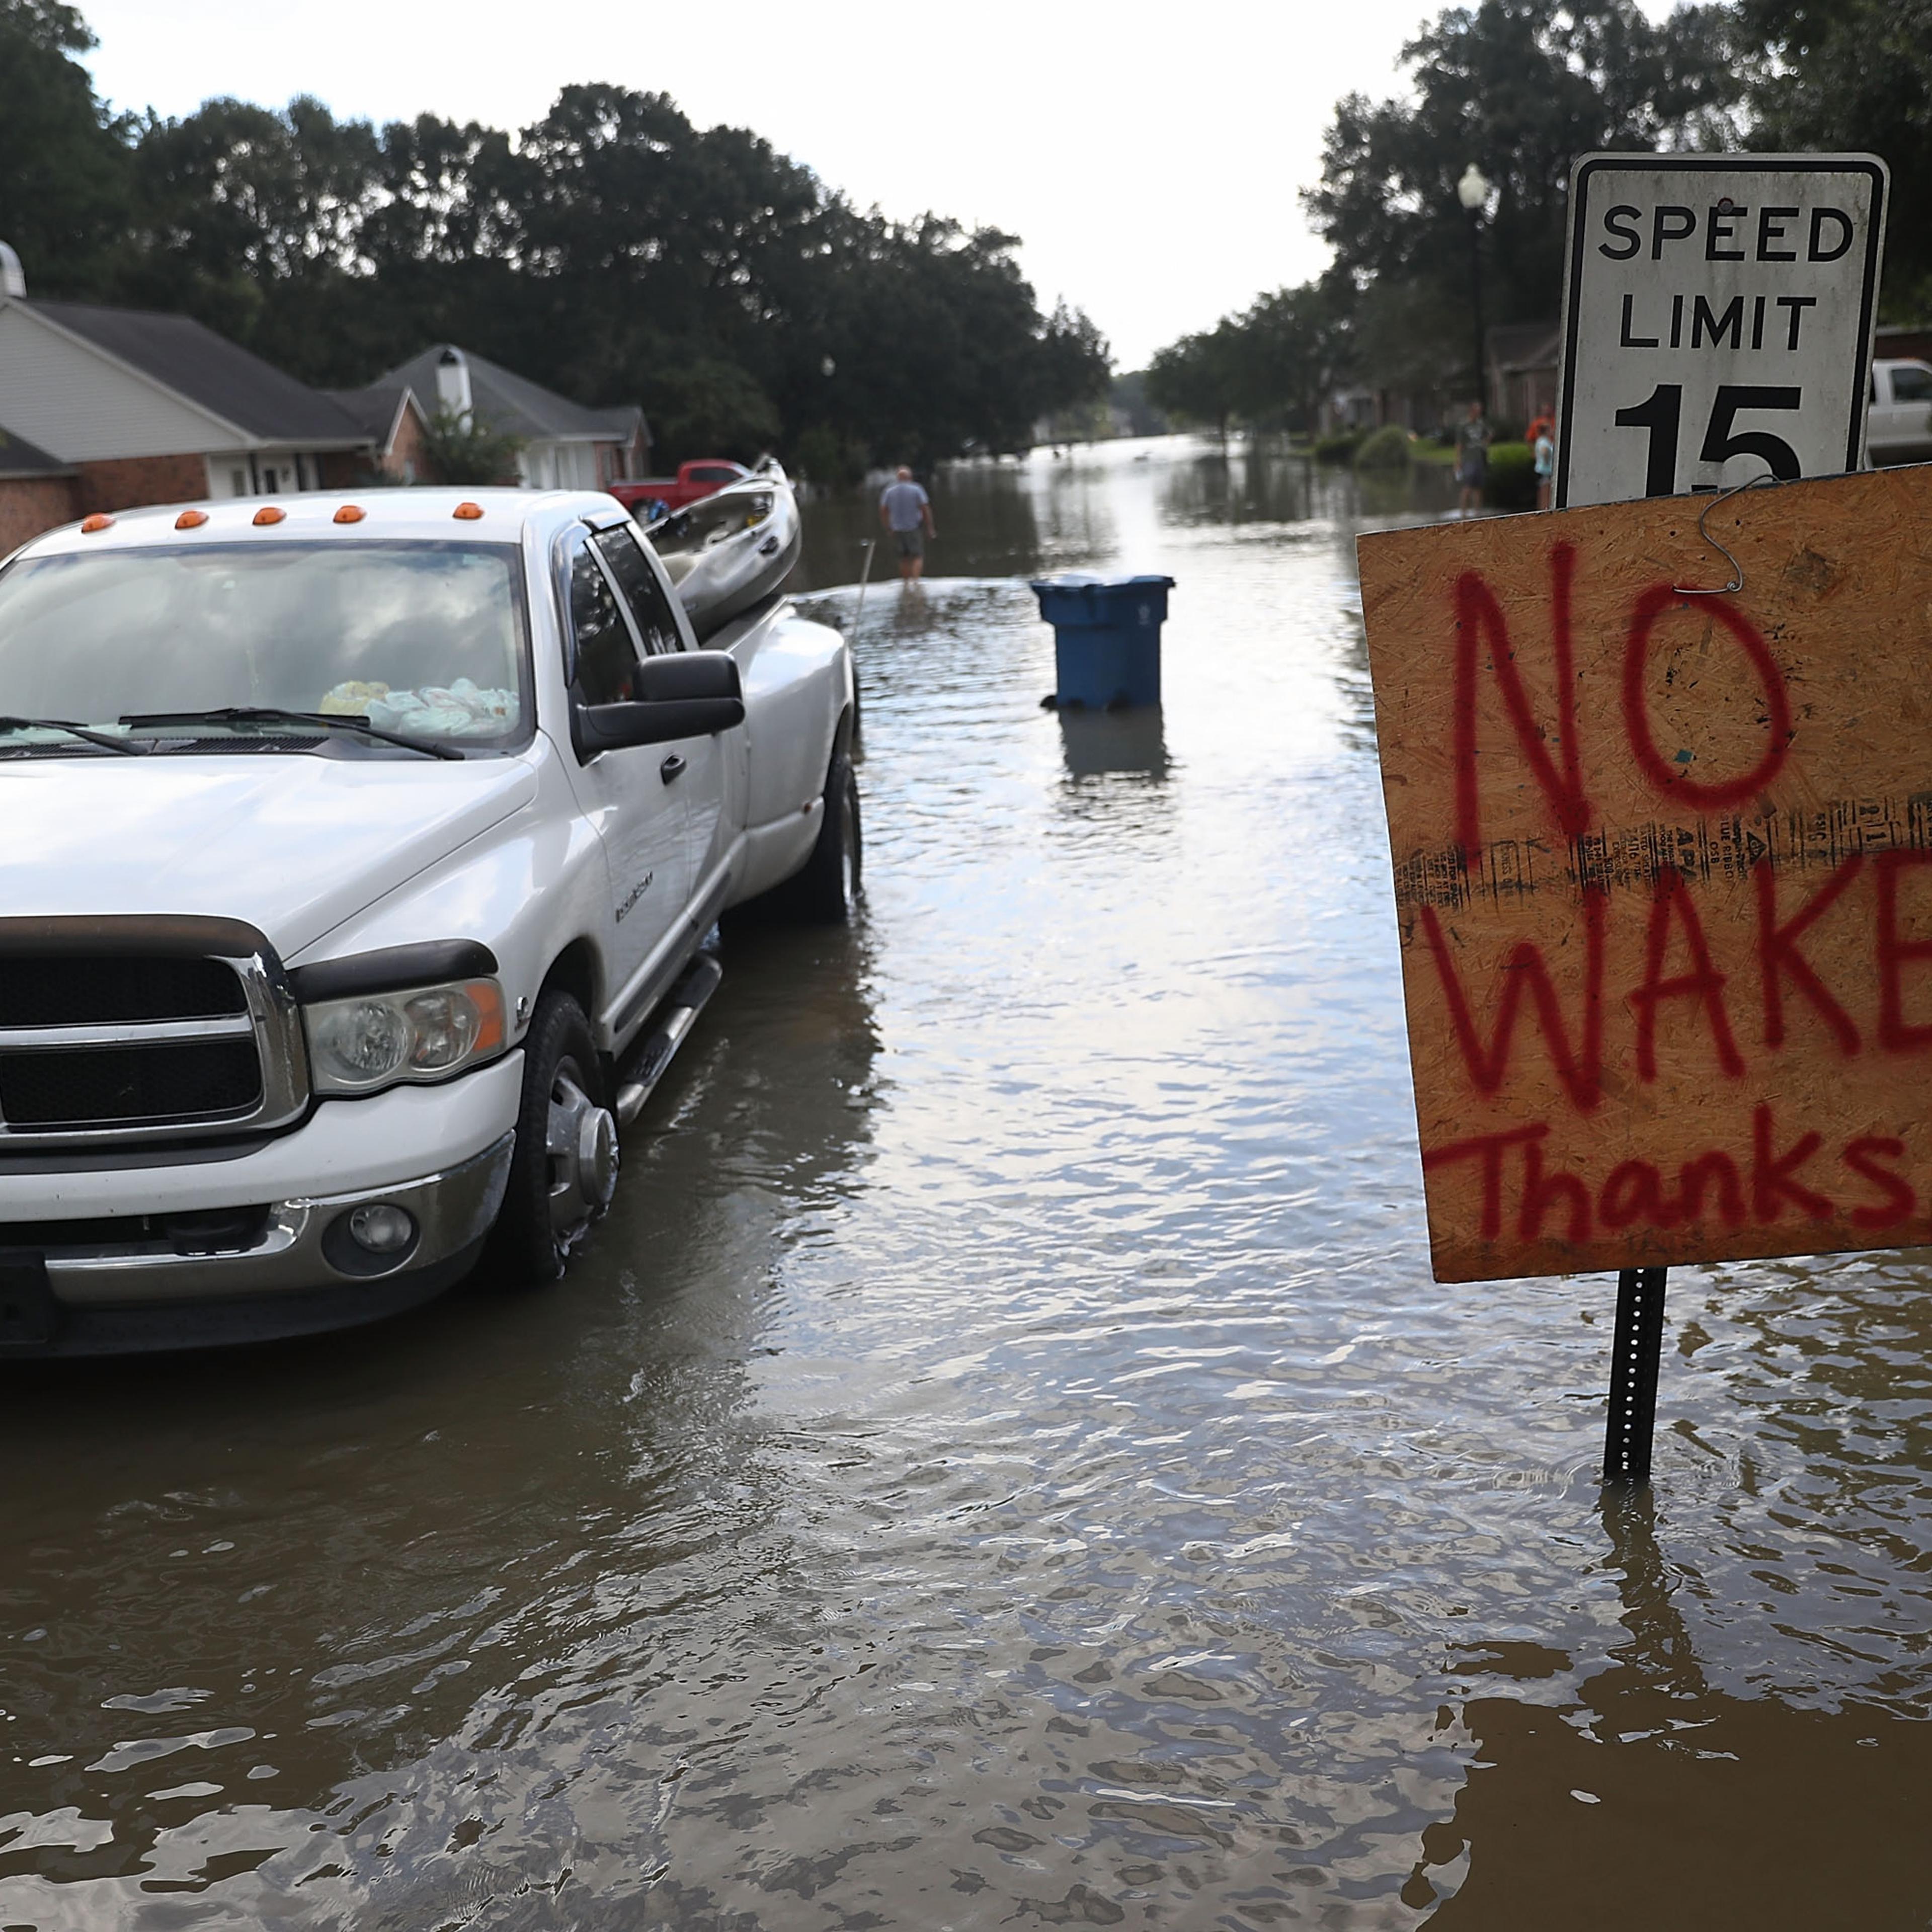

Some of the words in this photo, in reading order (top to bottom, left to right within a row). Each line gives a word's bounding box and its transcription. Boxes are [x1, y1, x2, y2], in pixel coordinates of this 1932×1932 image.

[1598, 204, 1854, 263] SPEED
[1620, 294, 1817, 351] LIMIT
[1614, 384, 1802, 498] 15
[1453, 539, 1792, 873] NO
[1710, 841, 1720, 864] OSB
[1722, 845, 1735, 881] RIBBO
[1416, 847, 1932, 1116] WAKE
[1422, 1102, 1916, 1244] Thanks
